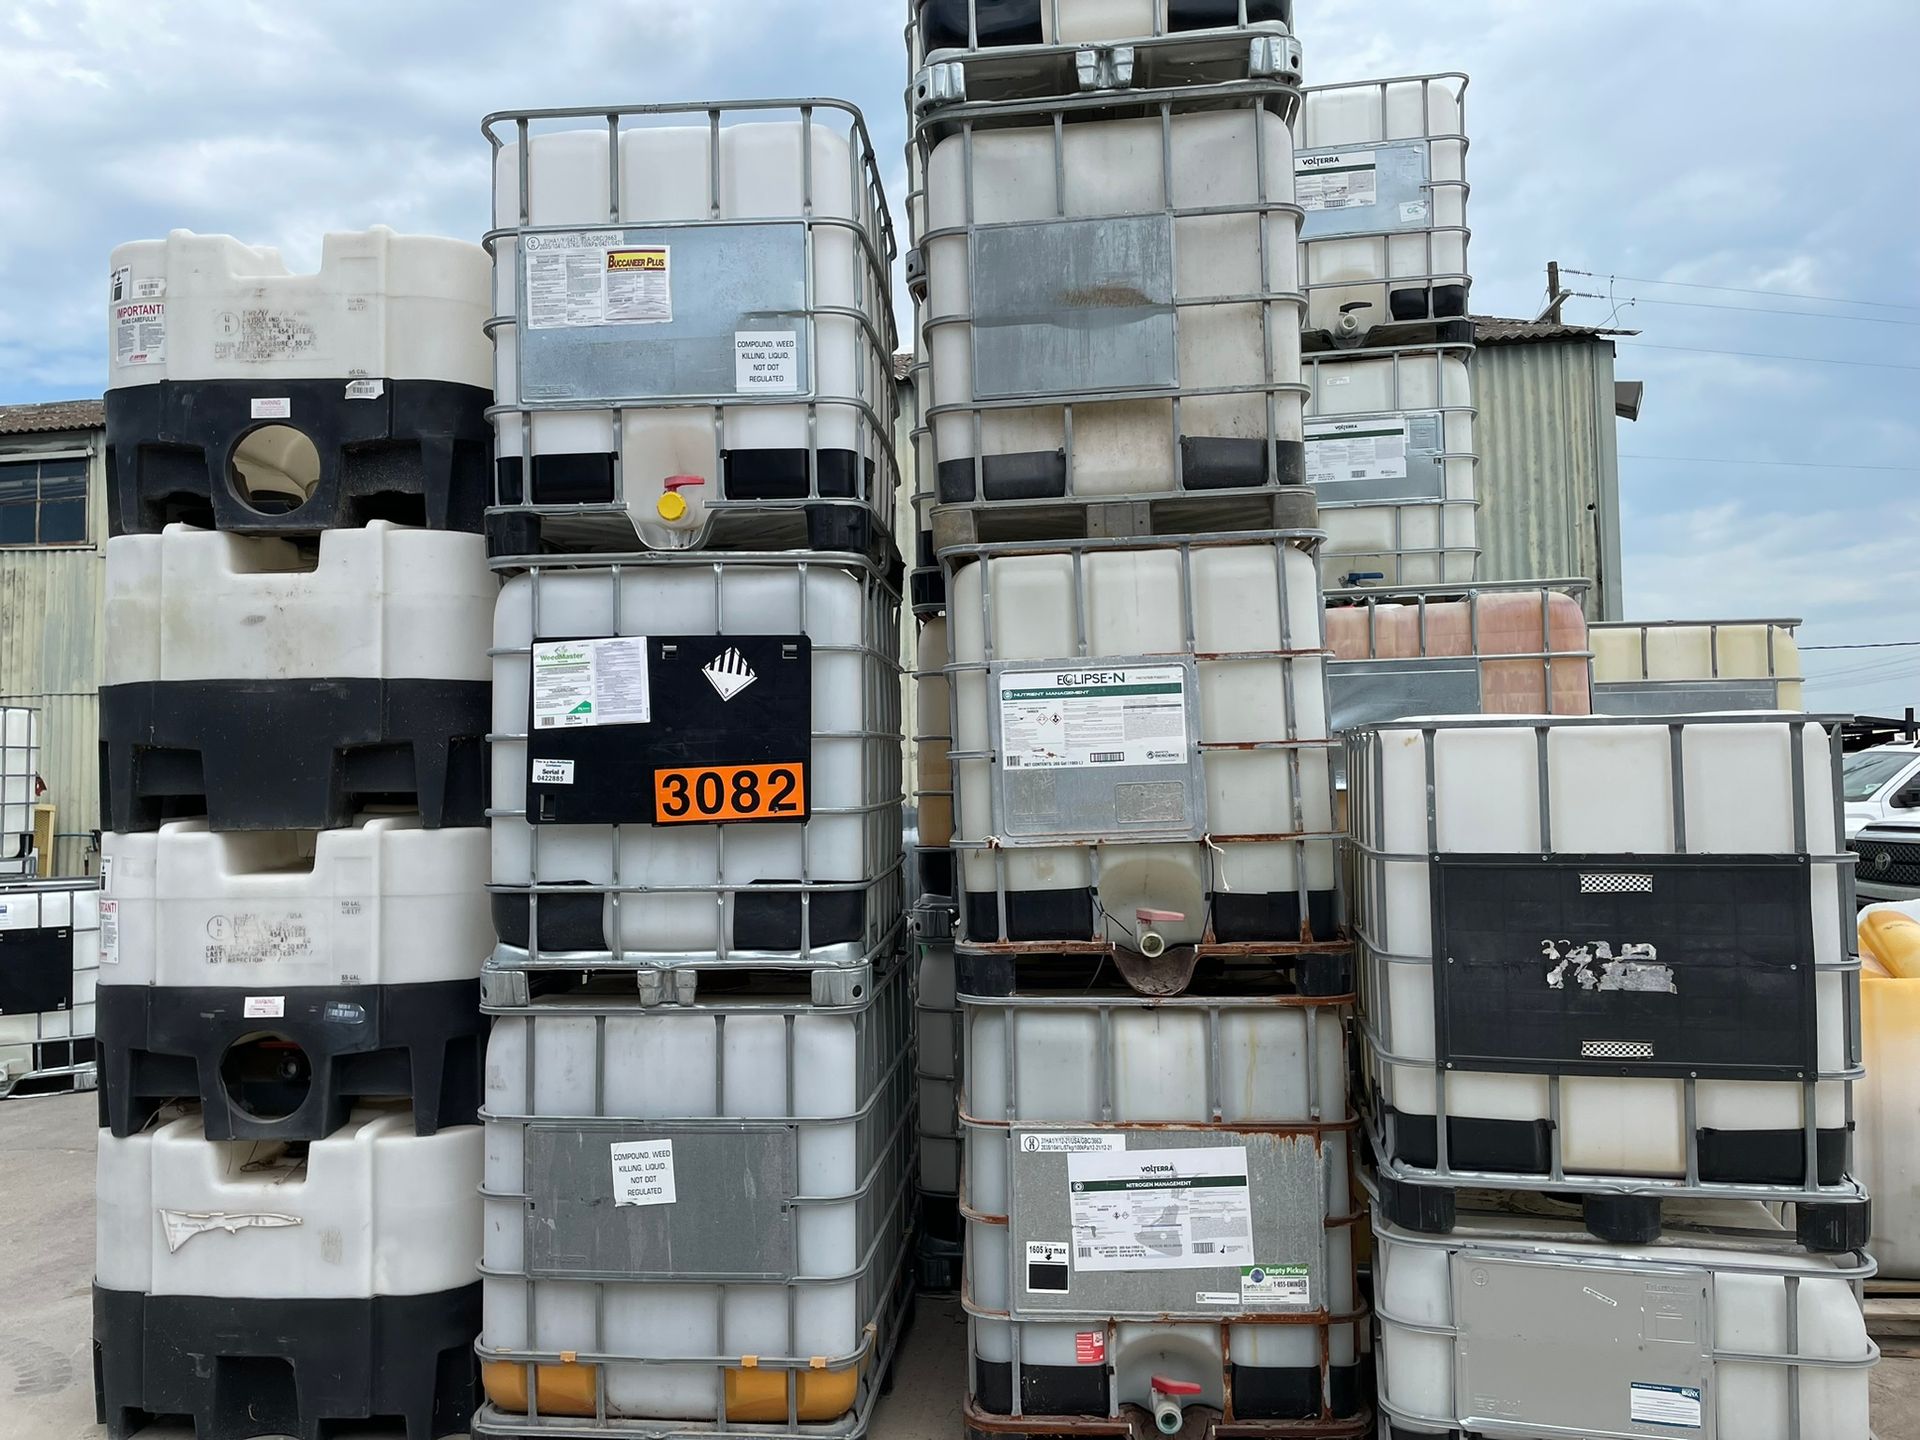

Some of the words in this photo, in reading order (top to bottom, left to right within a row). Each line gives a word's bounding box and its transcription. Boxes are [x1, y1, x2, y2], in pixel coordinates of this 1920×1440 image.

[1302, 157, 1340, 166] VOLTERRA
[117, 304, 164, 319] IMPORTANT!
[737, 341, 775, 349] COMPOUND,
[776, 340, 795, 348] WEED
[540, 653, 584, 662] WeedMaster
[1056, 672, 1125, 686] ECLIPSE-N
[662, 769, 797, 817] 3082
[614, 1152, 651, 1161] COMPOUND,
[652, 1150, 671, 1158] WEED
[1141, 1164, 1174, 1174] VOLTERRA
[644, 1175, 657, 1183] DOT
[627, 1187, 663, 1196] REGULATED
[1029, 1245, 1044, 1254] 1605
[1045, 1246, 1053, 1256] kg
[1286, 1267, 1307, 1275] Pickup
